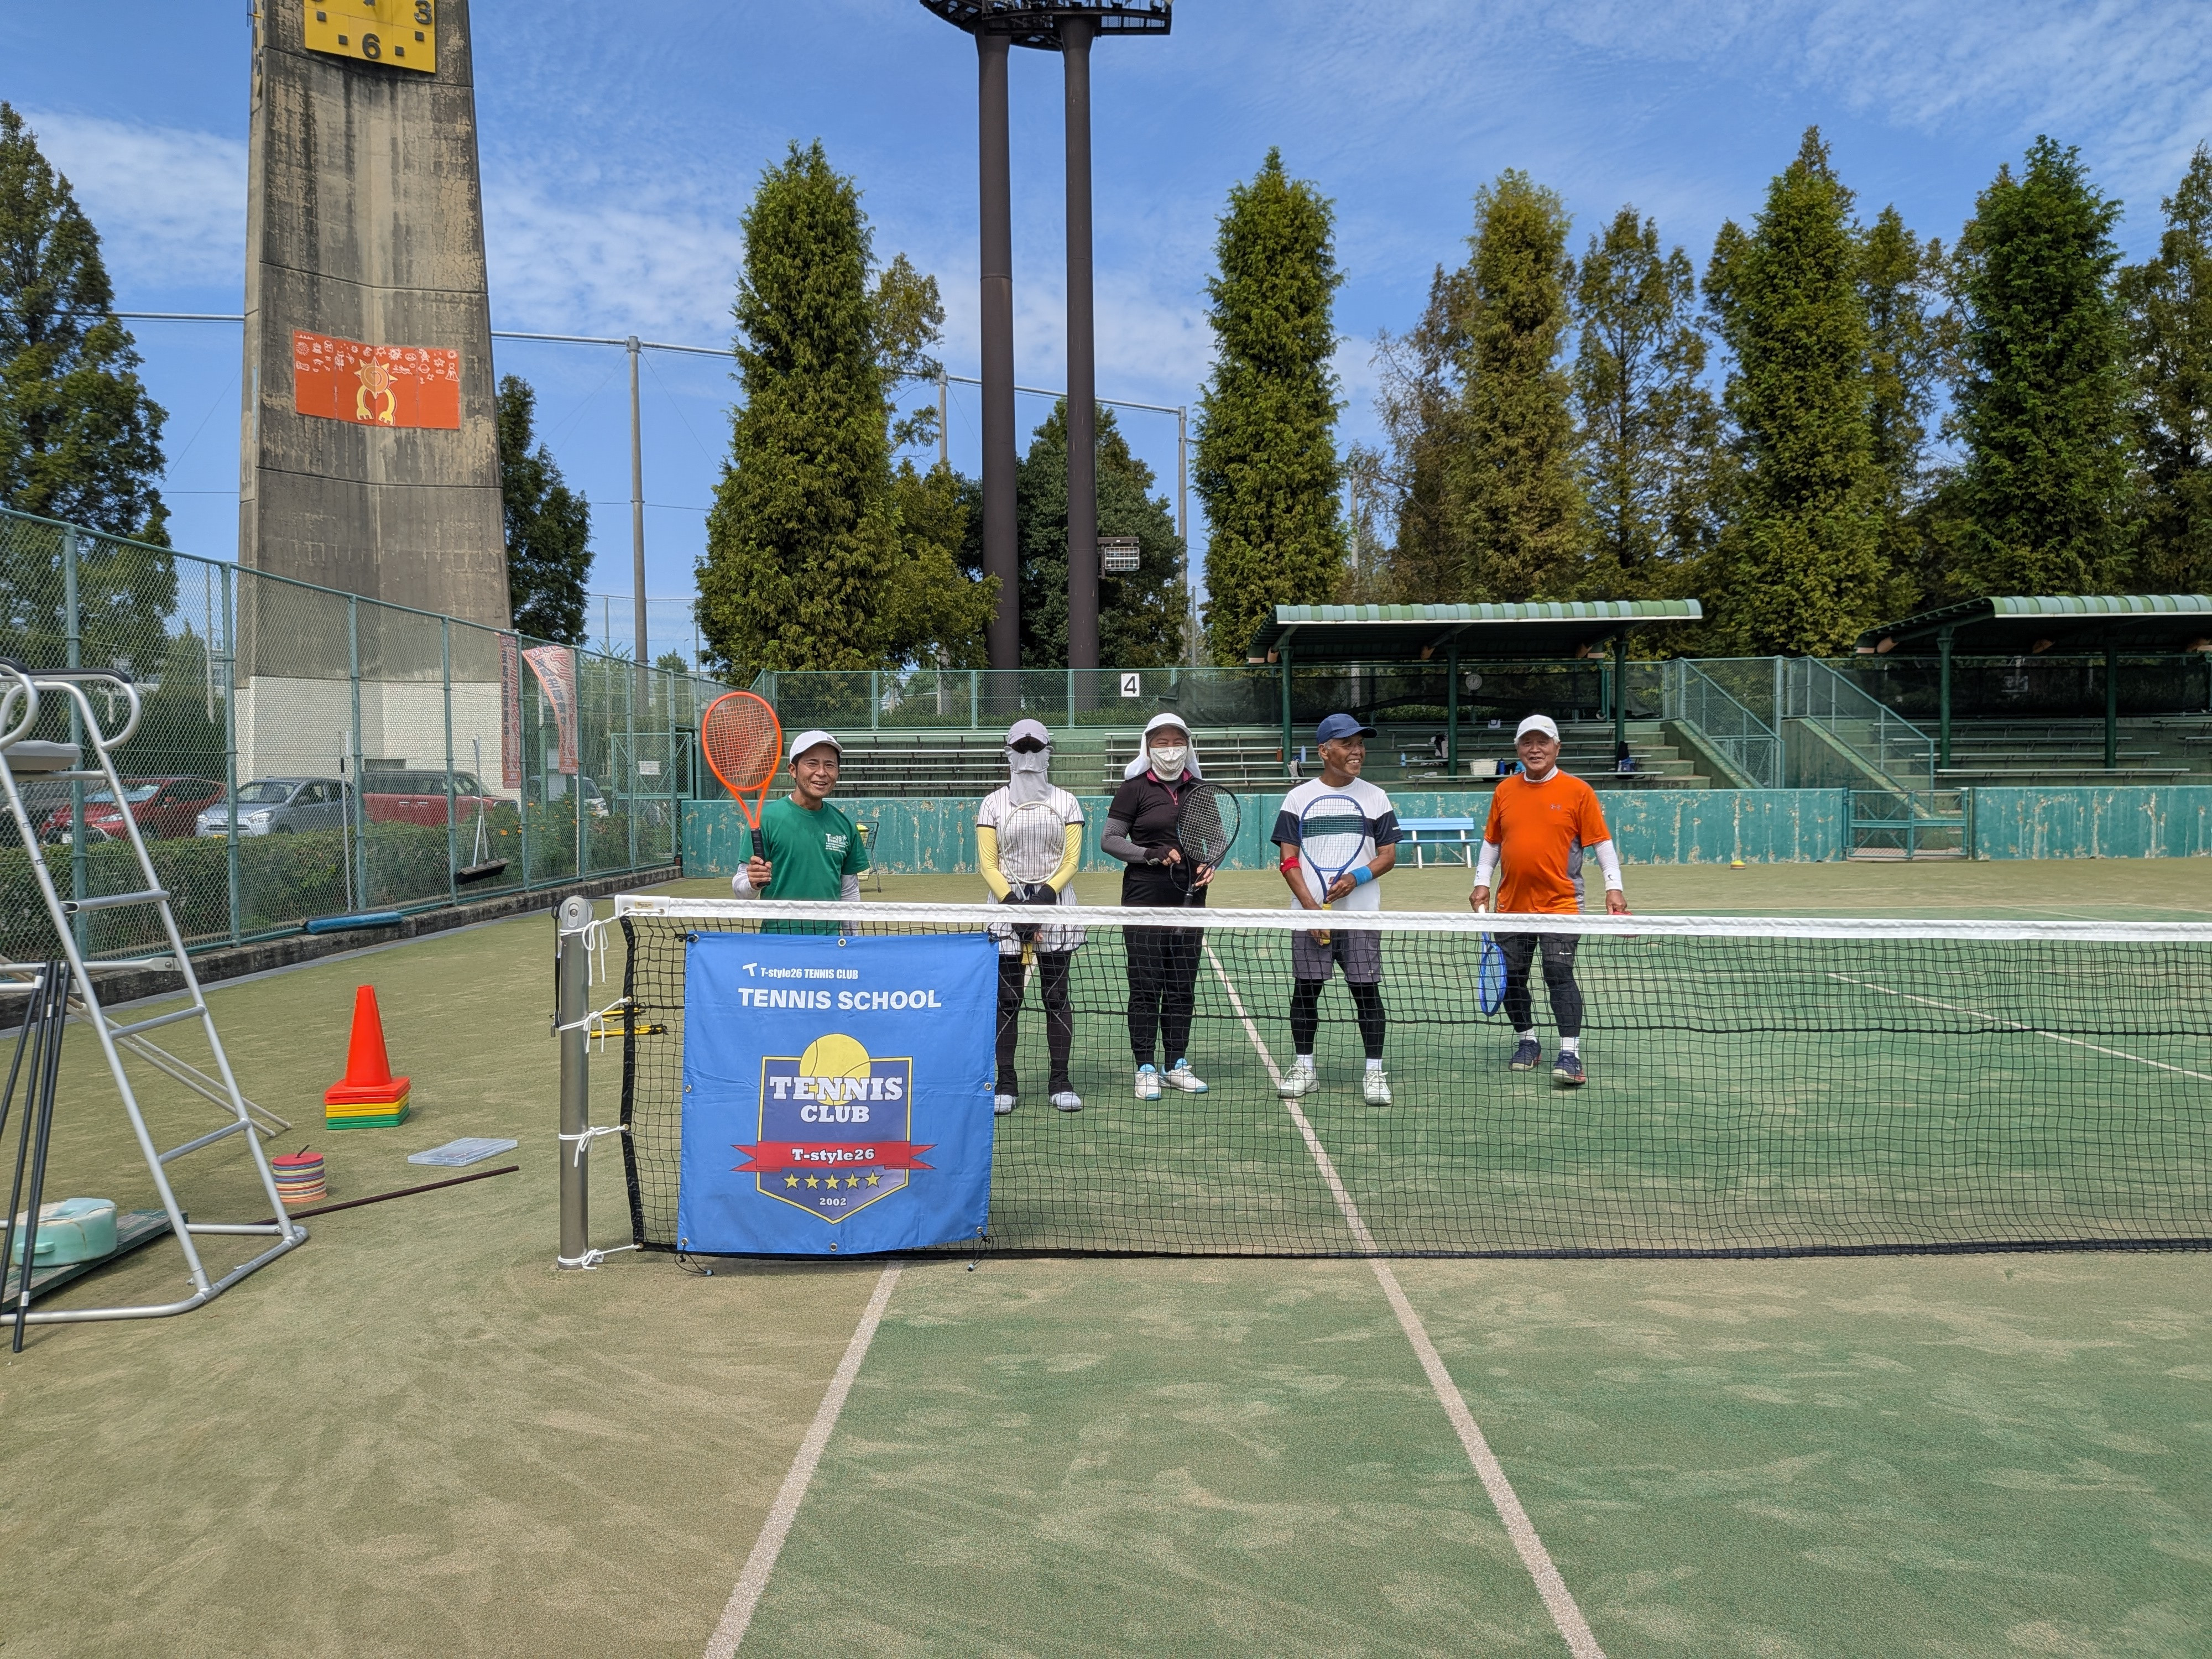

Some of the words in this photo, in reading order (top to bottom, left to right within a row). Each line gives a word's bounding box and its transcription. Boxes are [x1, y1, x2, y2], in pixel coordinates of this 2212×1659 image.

[414, 0, 432, 24] 3
[362, 33, 381, 59] 6
[1124, 676, 1137, 694] 4
[760, 967, 802, 979] T-style26
[804, 969, 834, 979] TENNIS
[836, 969, 858, 979] CLUB
[738, 988, 831, 1009] TENNIS
[837, 990, 942, 1010] SCHOOL
[769, 1076, 903, 1101] TENNIS
[800, 1105, 869, 1123] CLUB
[791, 1148, 875, 1164] T-style26
[819, 1197, 847, 1207] 2002
